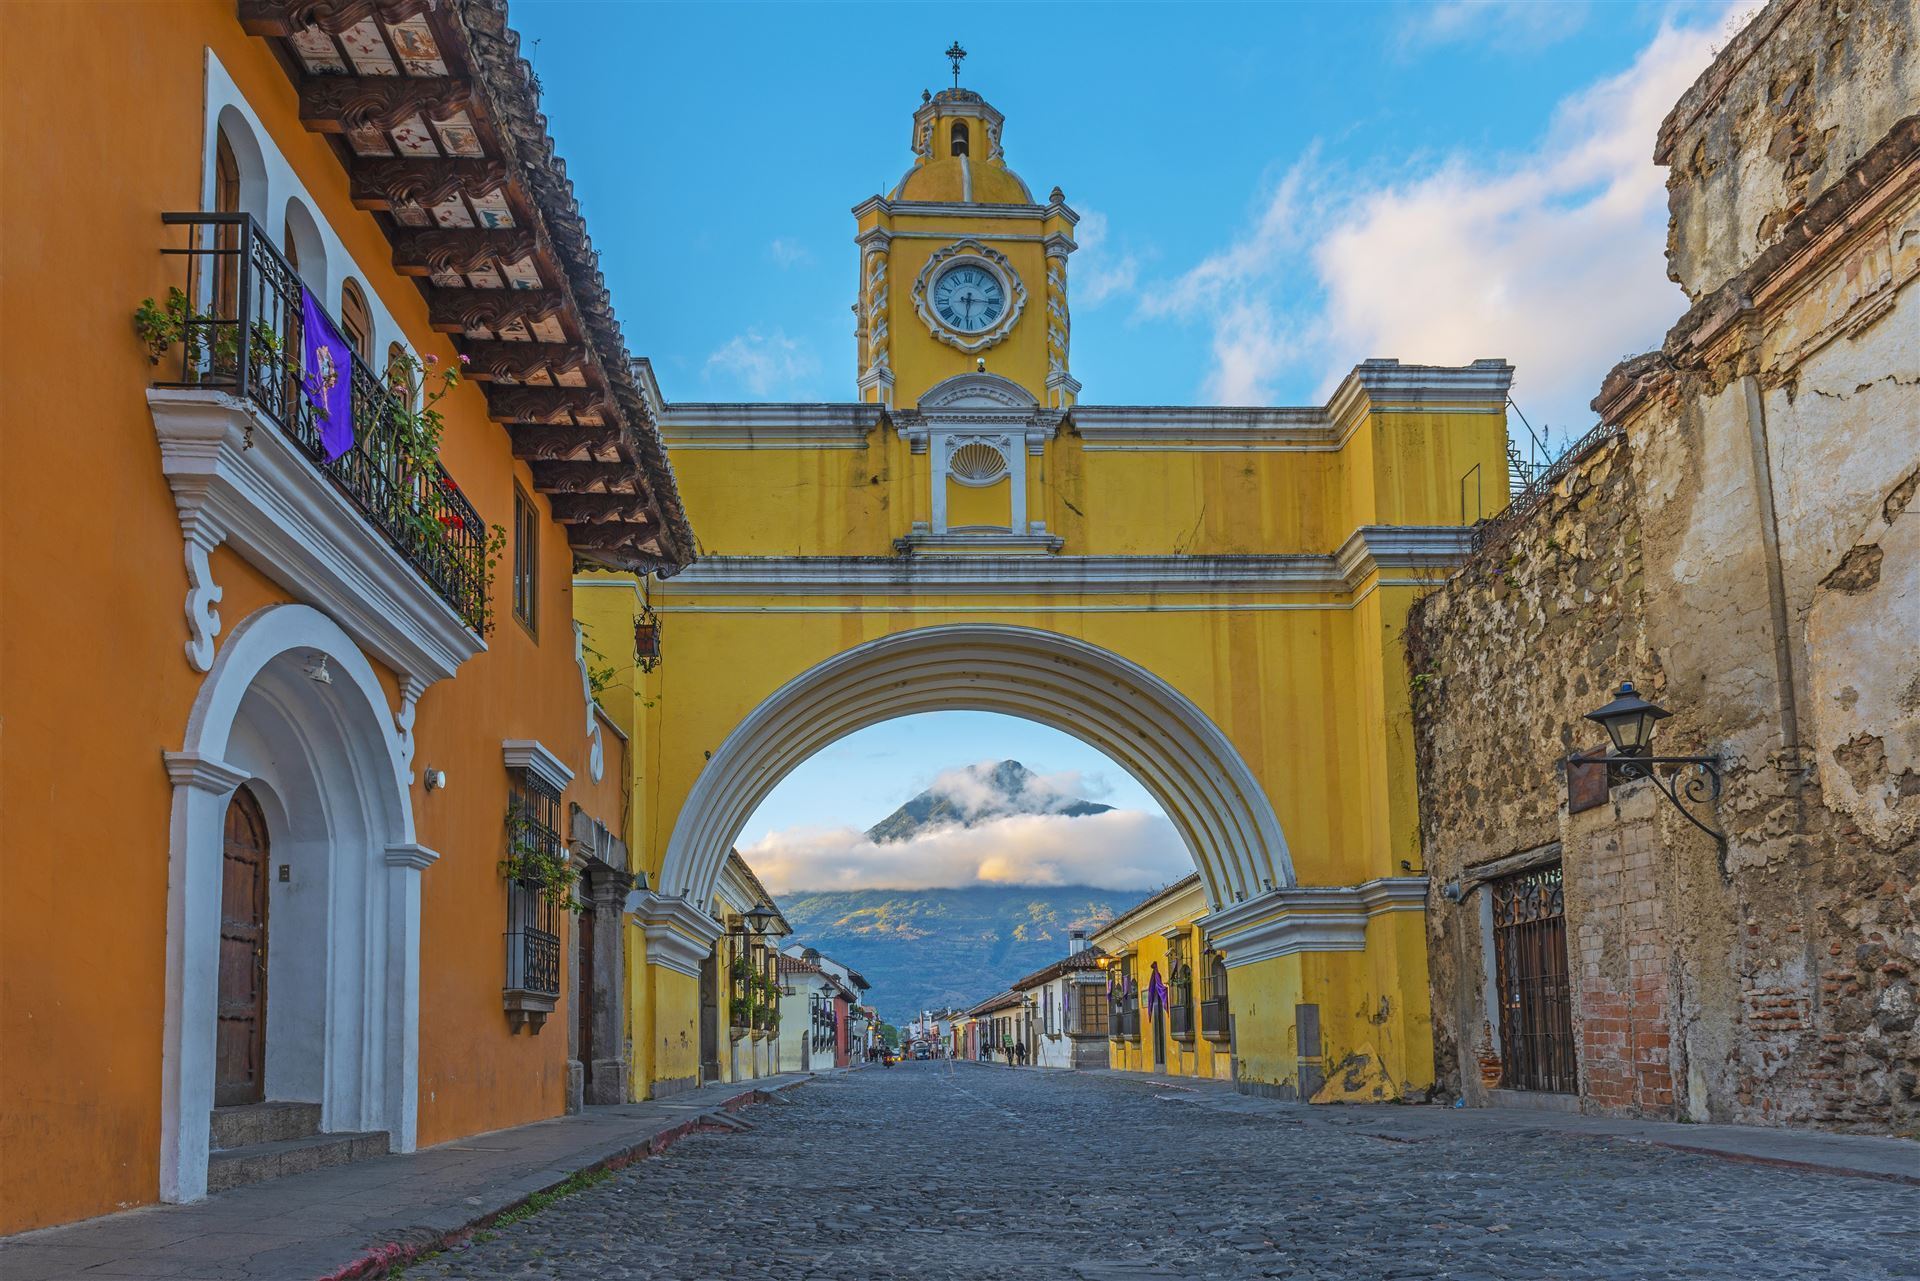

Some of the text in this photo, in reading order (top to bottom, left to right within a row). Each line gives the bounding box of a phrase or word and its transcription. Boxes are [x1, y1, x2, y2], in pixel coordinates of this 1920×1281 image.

[951, 276, 961, 286] XI
[964, 272, 973, 283] XII
[976, 276, 984, 286] I
[941, 285, 952, 294] X
[985, 286, 995, 294] II
